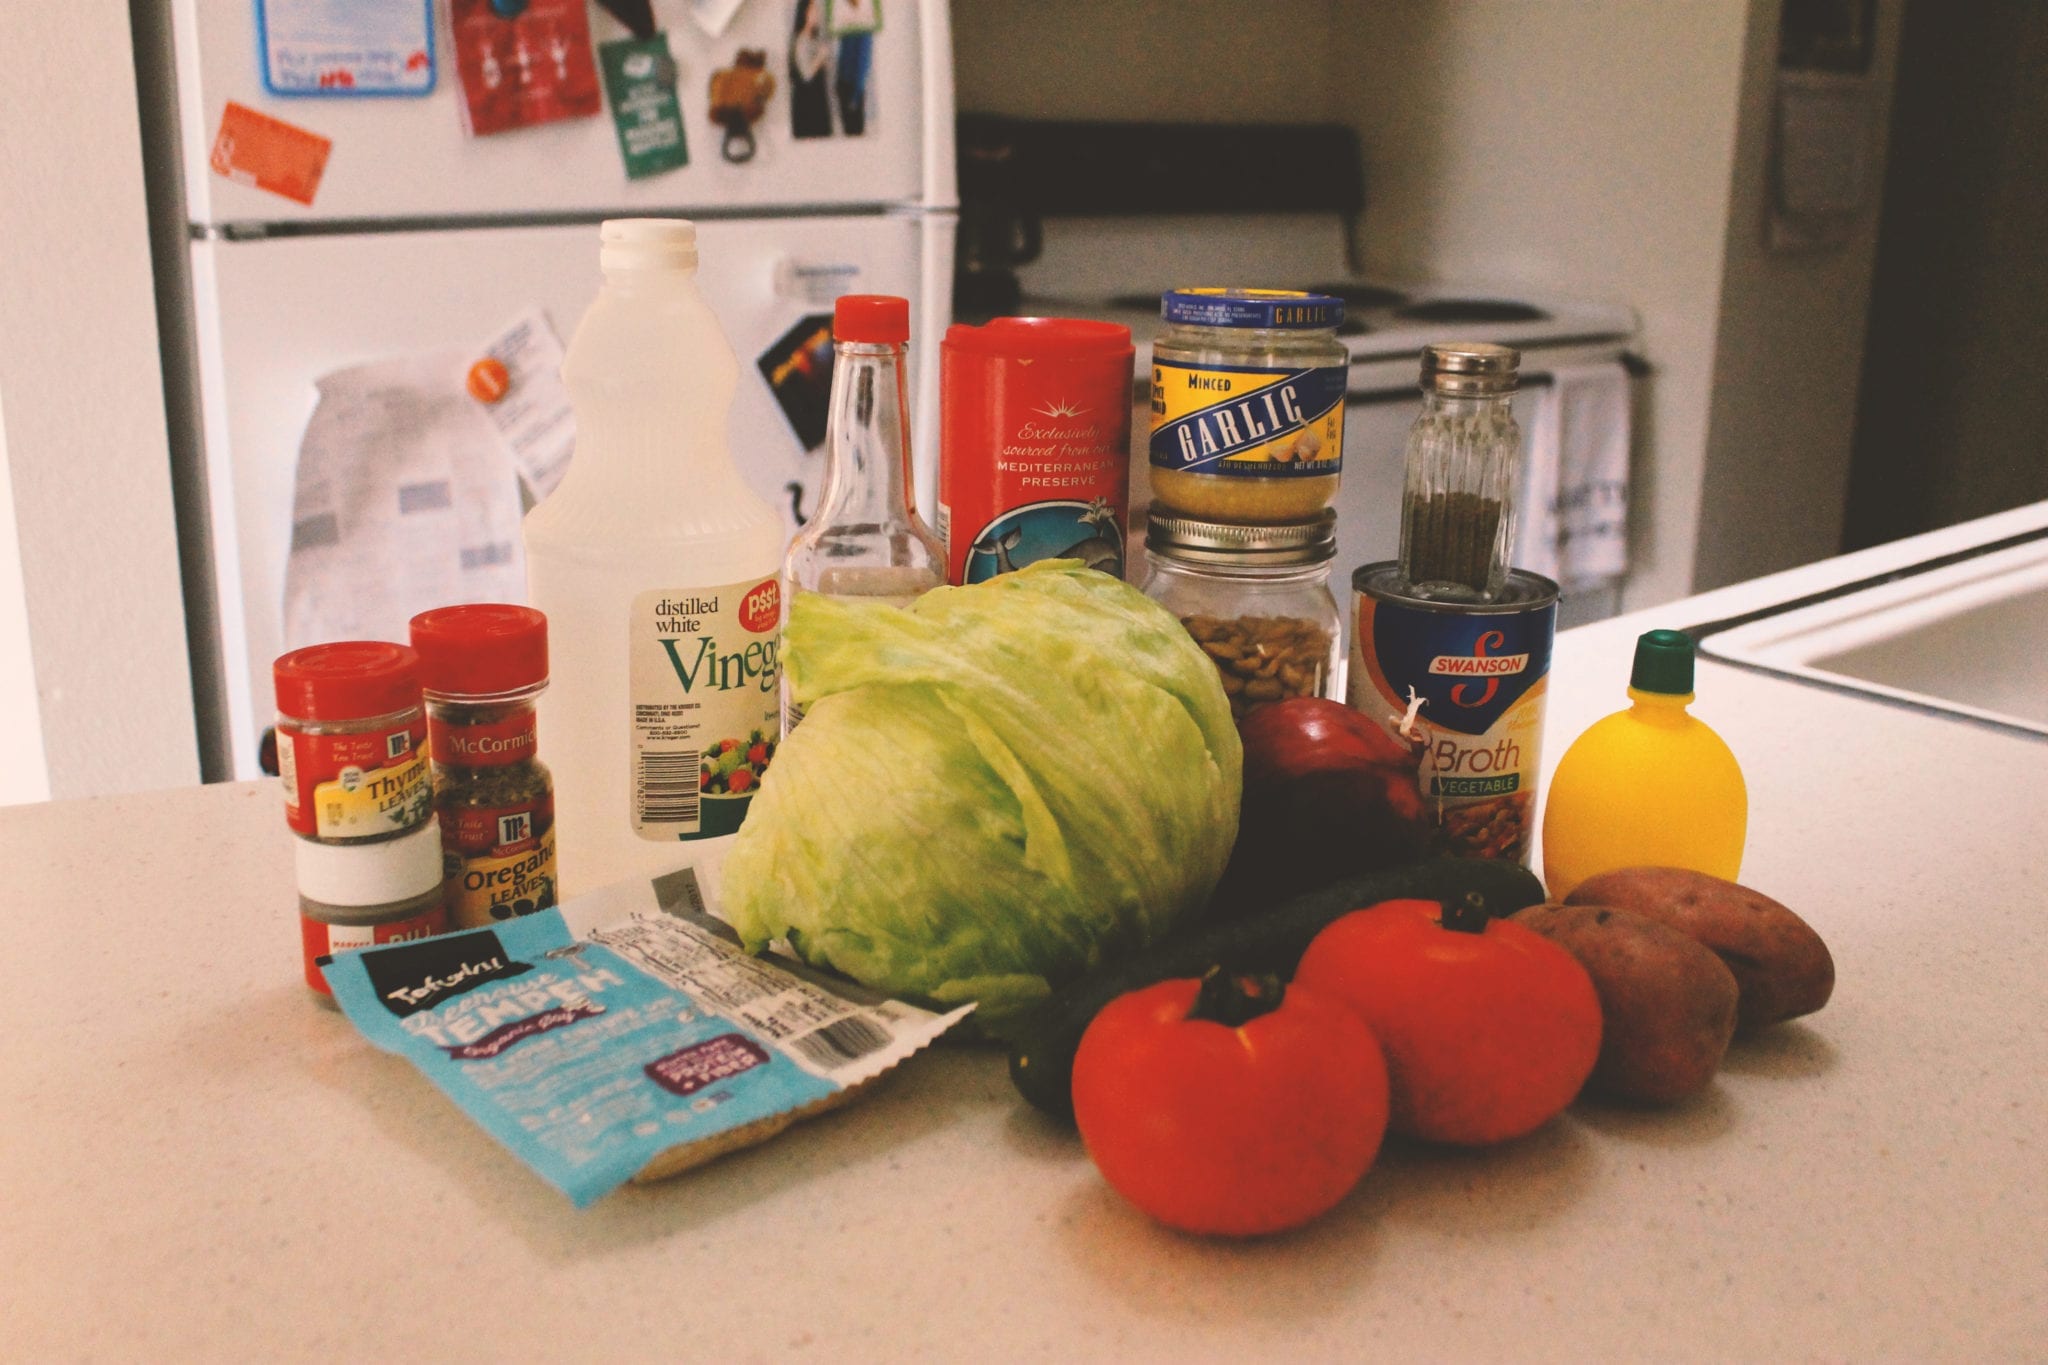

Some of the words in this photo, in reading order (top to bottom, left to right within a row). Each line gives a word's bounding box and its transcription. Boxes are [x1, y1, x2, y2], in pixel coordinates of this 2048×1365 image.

[1275, 305, 1328, 324] GARLIC
[1188, 373, 1232, 392] MINCED
[1017, 422, 1103, 442] Exclusively
[1176, 385, 1304, 462] GARLIC
[1002, 443, 1055, 457] sourced
[1060, 443, 1090, 460] from
[996, 459, 1117, 473] MEDITERRANEAN
[1021, 476, 1097, 488] PRESERVE
[655, 596, 719, 616] distilled
[656, 616, 701, 633] white
[1435, 657, 1522, 673] SWANSON
[1434, 738, 1520, 773] Broth
[1439, 776, 1515, 795] VEGETABLE
[463, 840, 555, 892] Oregano
[489, 872, 546, 906] LEAVES
